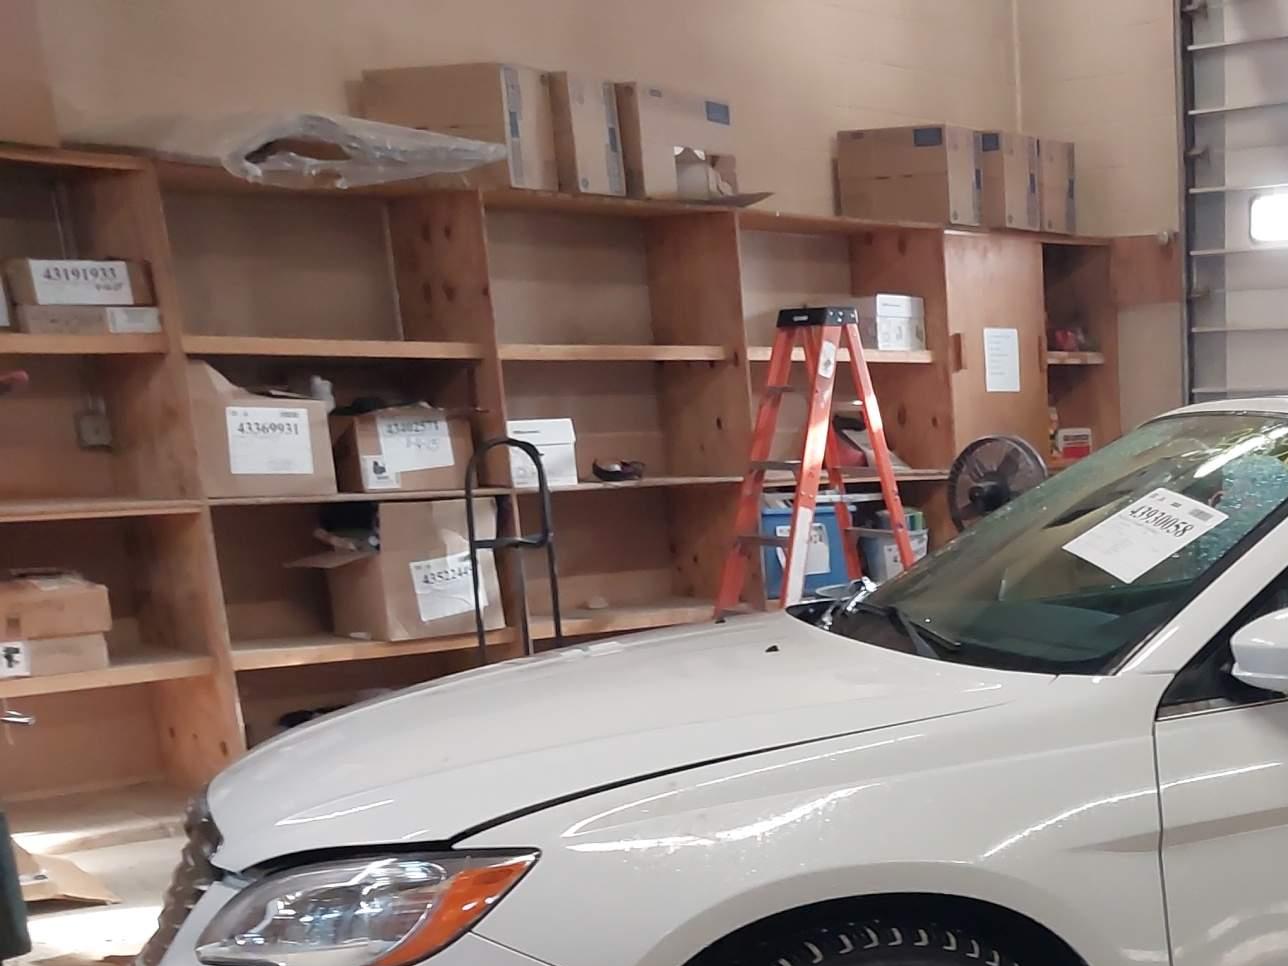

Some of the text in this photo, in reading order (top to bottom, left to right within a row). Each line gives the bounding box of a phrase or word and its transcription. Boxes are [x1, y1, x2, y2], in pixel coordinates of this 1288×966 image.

[43, 267, 118, 281] 43191933
[237, 422, 300, 434] 43369931
[1129, 505, 1194, 537] 43930058
